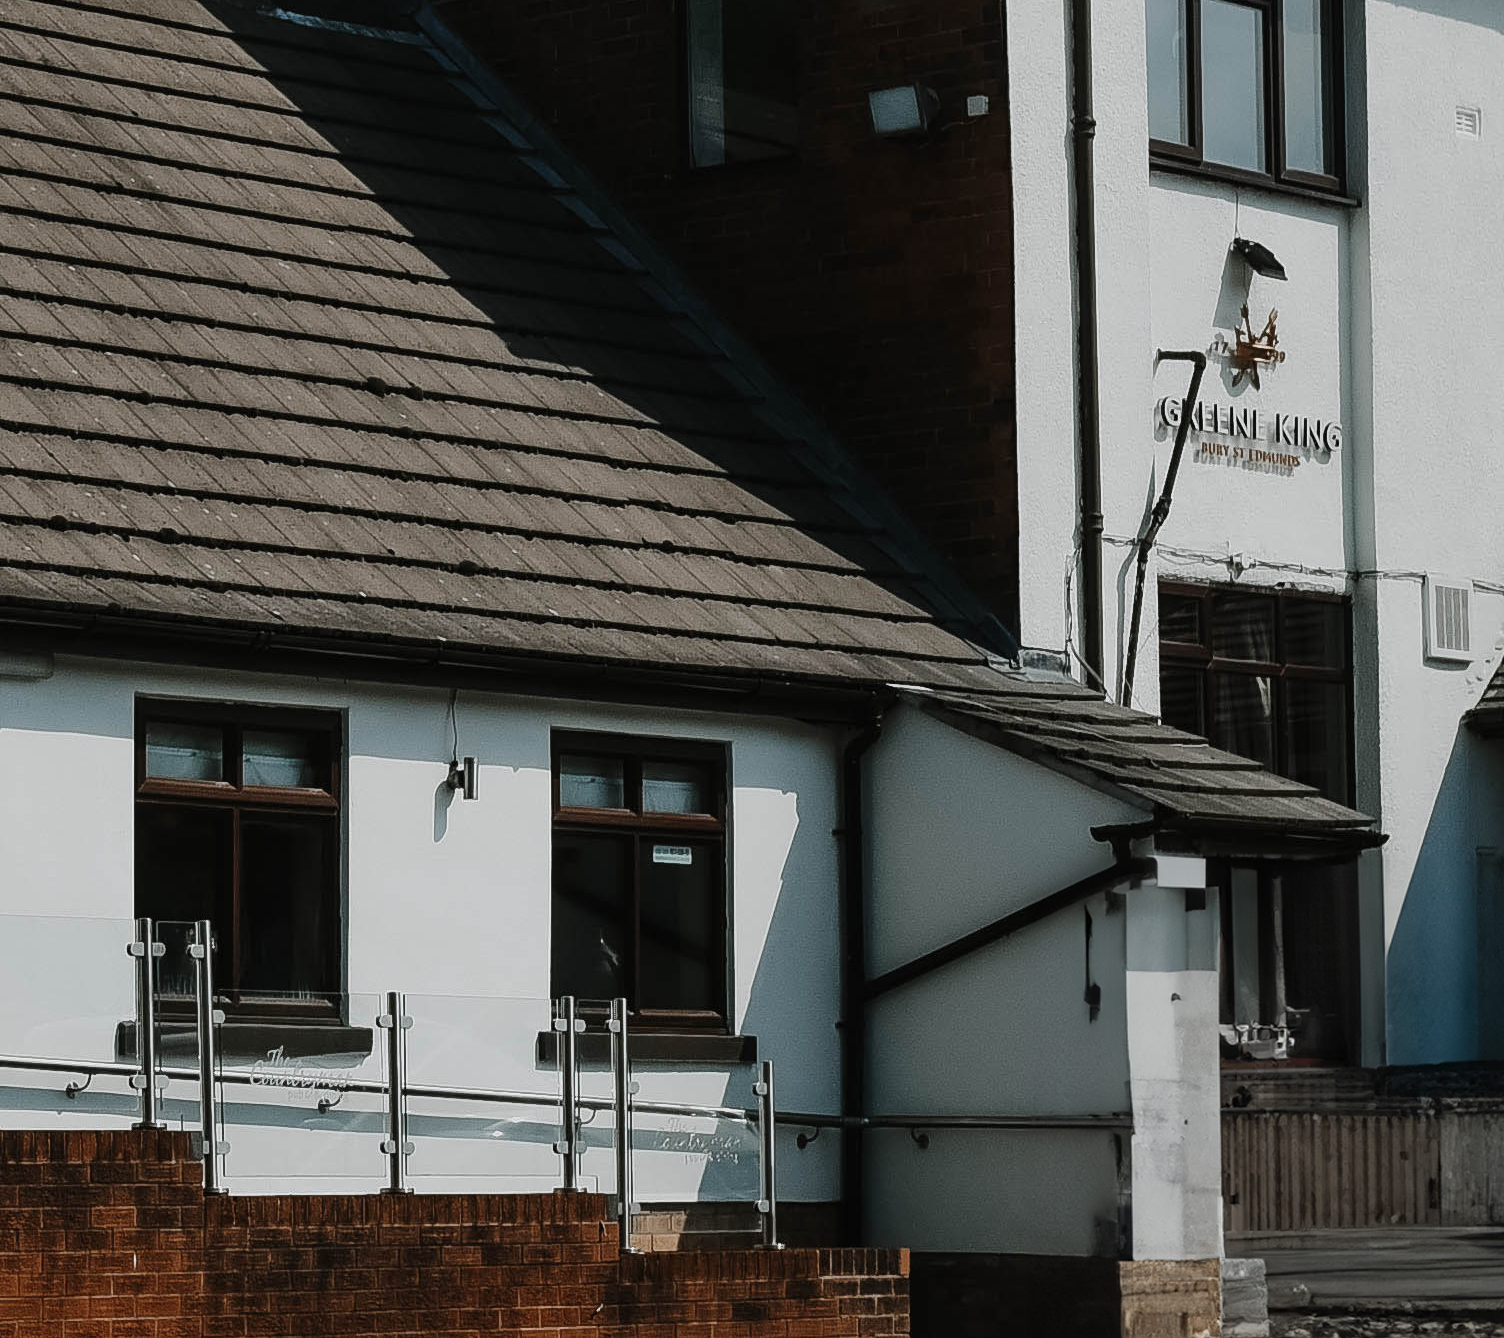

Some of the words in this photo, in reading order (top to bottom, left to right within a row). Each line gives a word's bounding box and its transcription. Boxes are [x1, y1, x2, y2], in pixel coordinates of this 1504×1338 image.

[1275, 412, 1342, 452] KING
[1201, 441, 1230, 459] BURY
[1232, 445, 1245, 460] ST
[1248, 448, 1301, 467] EDMUNDS
